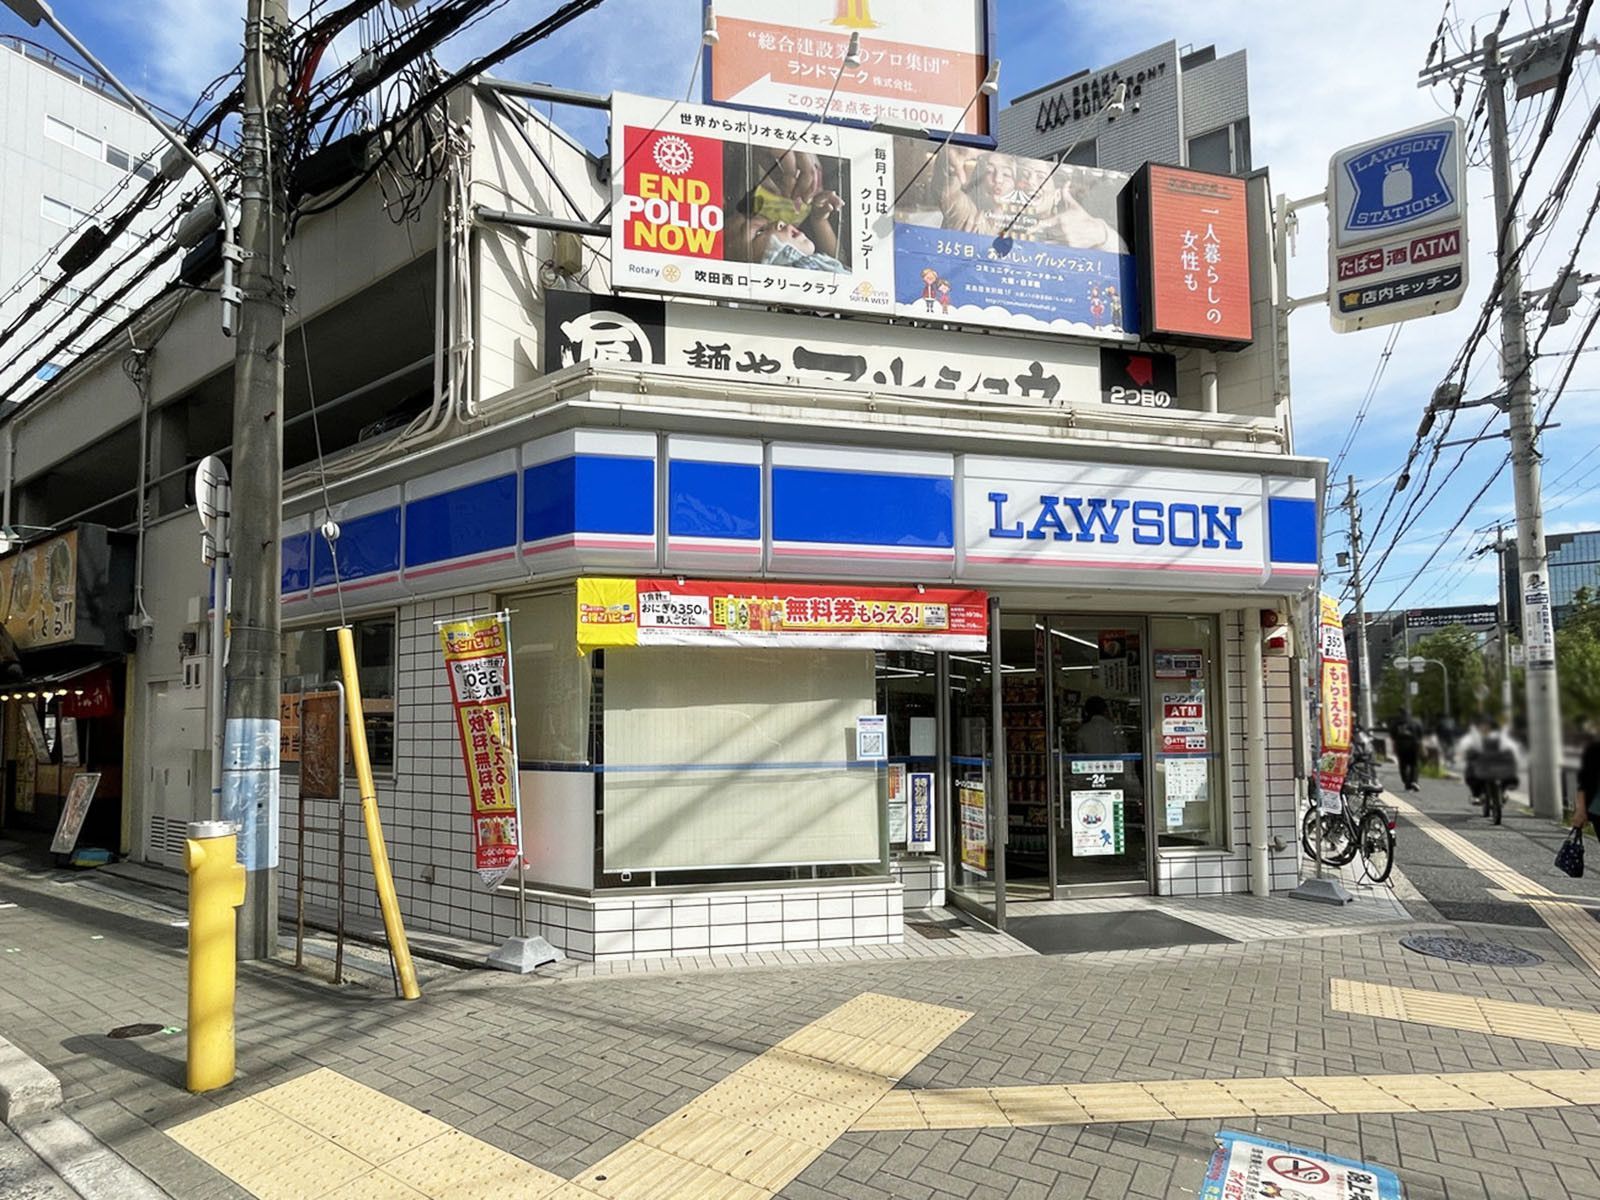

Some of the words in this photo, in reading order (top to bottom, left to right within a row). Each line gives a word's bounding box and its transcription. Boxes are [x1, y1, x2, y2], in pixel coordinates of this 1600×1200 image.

[787, 60, 869, 85] ランドマーク
[680, 112, 833, 148] 世界からポリオをなくそう
[1355, 138, 1441, 173] LAWSON
[639, 173, 710, 205] END
[874, 147, 888, 215] 毎月1日は
[623, 194, 724, 232] POLIO
[1356, 193, 1441, 225] STATION
[633, 221, 717, 255] NOW
[860, 188, 873, 271] クリーンデー
[629, 263, 660, 278] Rotary
[1180, 229, 1201, 292] 女性も
[1201, 208, 1222, 324] 一人暮らしの
[1340, 254, 1382, 277] たばこ
[1386, 248, 1407, 266] 酒
[1413, 236, 1457, 260] ATM
[1361, 273, 1458, 305] 店内キッチン
[1110, 386, 1171, 408] 2つ目の
[988, 492, 1242, 549] LAWSON
[1170, 704, 1197, 717] ATM
[1092, 774, 1106, 784] 24
